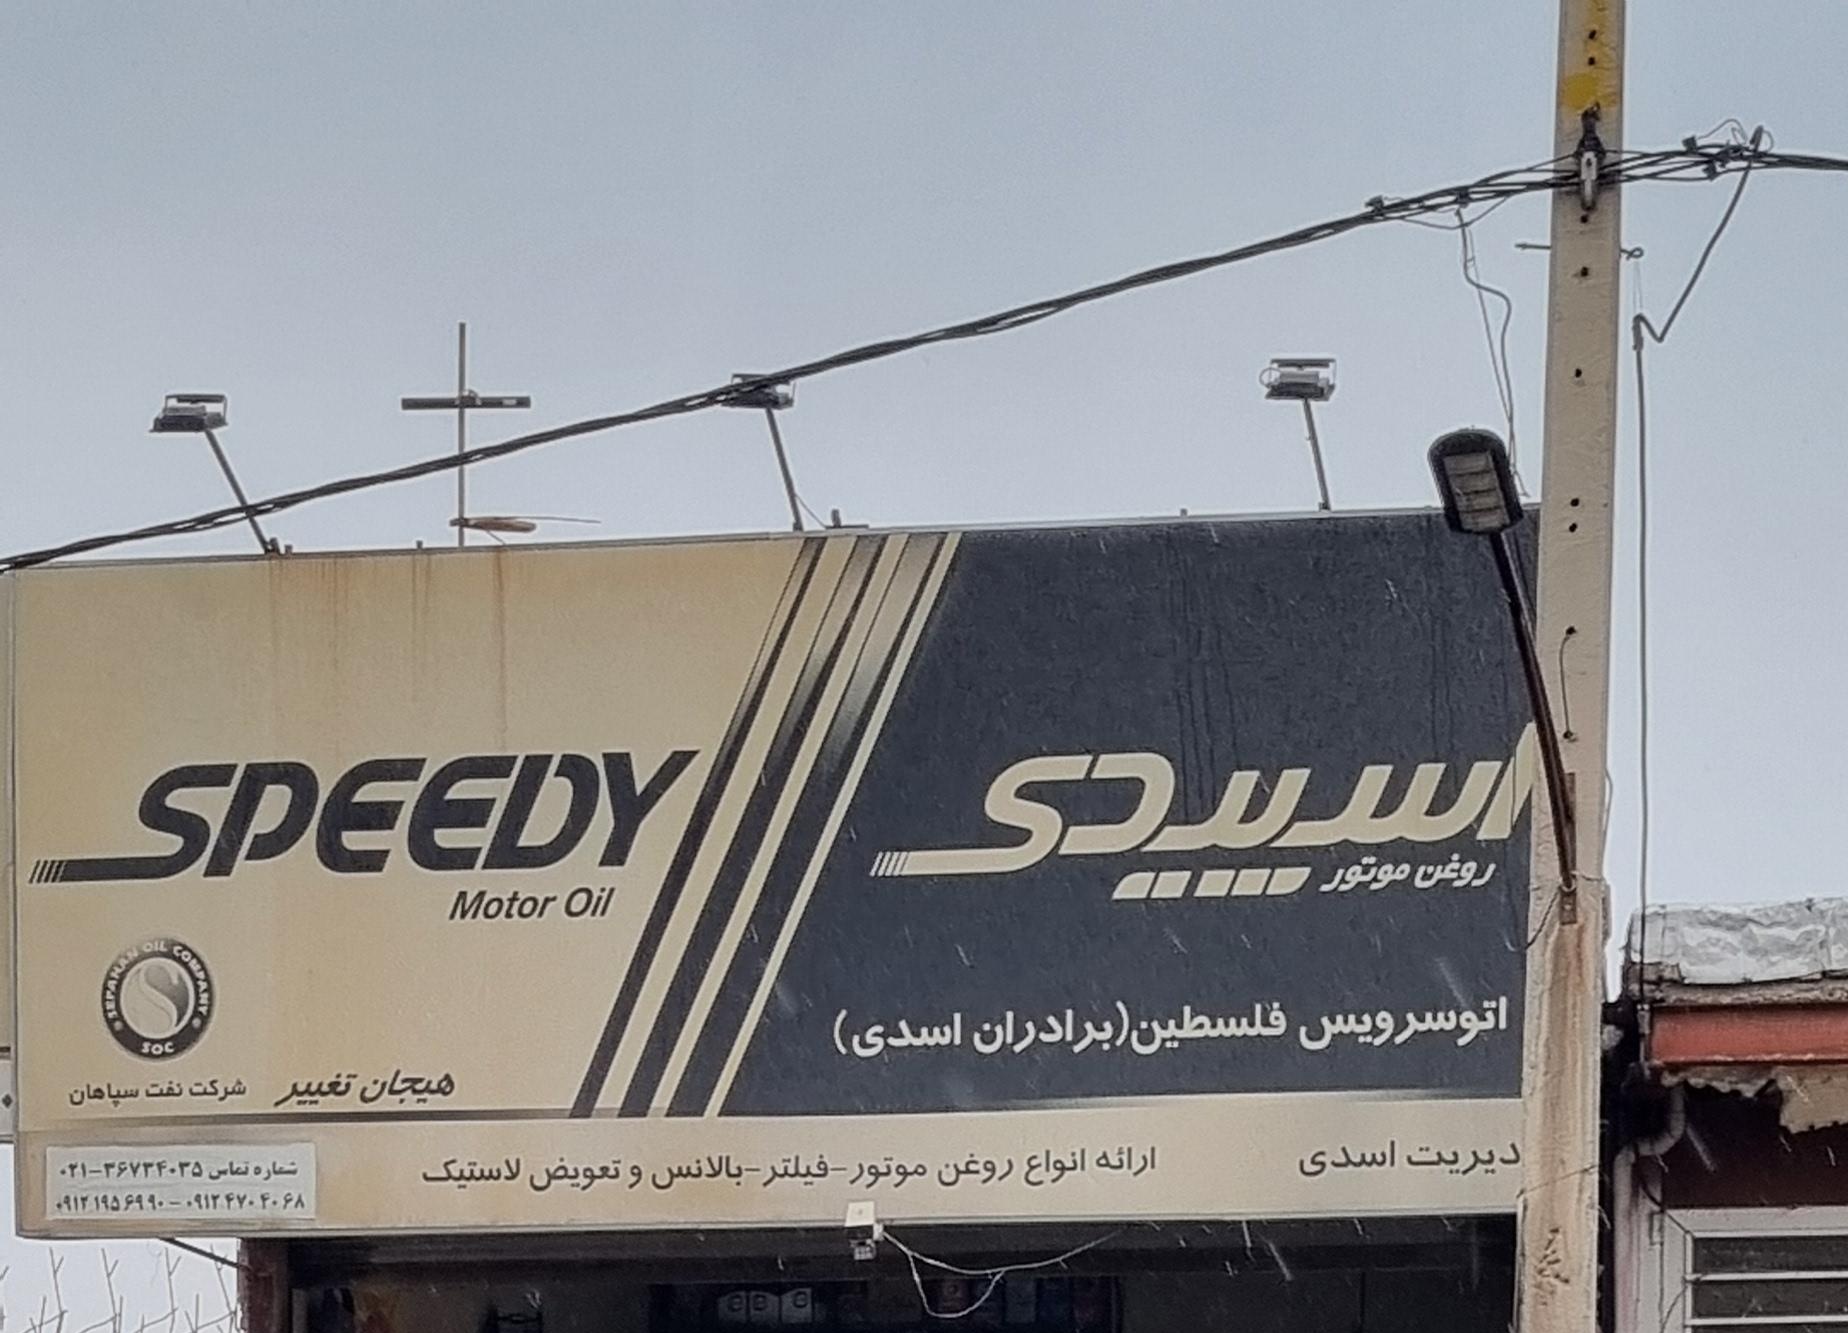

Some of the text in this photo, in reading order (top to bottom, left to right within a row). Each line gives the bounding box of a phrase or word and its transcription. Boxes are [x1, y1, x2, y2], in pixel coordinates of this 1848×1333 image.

[28, 750, 701, 884] SPEEDY
[1319, 857, 1496, 893] روغن موتور
[449, 886, 616, 920] Motor Oil
[105, 940, 209, 1019] SEPAHAN OIL COMPANY
[833, 1007, 962, 1058] اسدی)
[1299, 996, 1507, 1050] اتوسرویس
[141, 1041, 174, 1055] SOC
[68, 1078, 246, 1108] شرکت نفت سپاهان
[273, 1069, 455, 1107] هیجان تغییر
[207, 1160, 249, 1181] تماس
[252, 1160, 298, 1181] شماره
[421, 1158, 521, 1190] لاستیک
[528, 1157, 621, 1192] تعویض
[937, 1153, 1014, 1187] روغن
[1023, 1148, 1086, 1187] انواع
[1095, 1145, 1156, 1176] ارائه
[1299, 1139, 1521, 1177] دیریت اسدی
[627, 1167, 643, 1189] و
